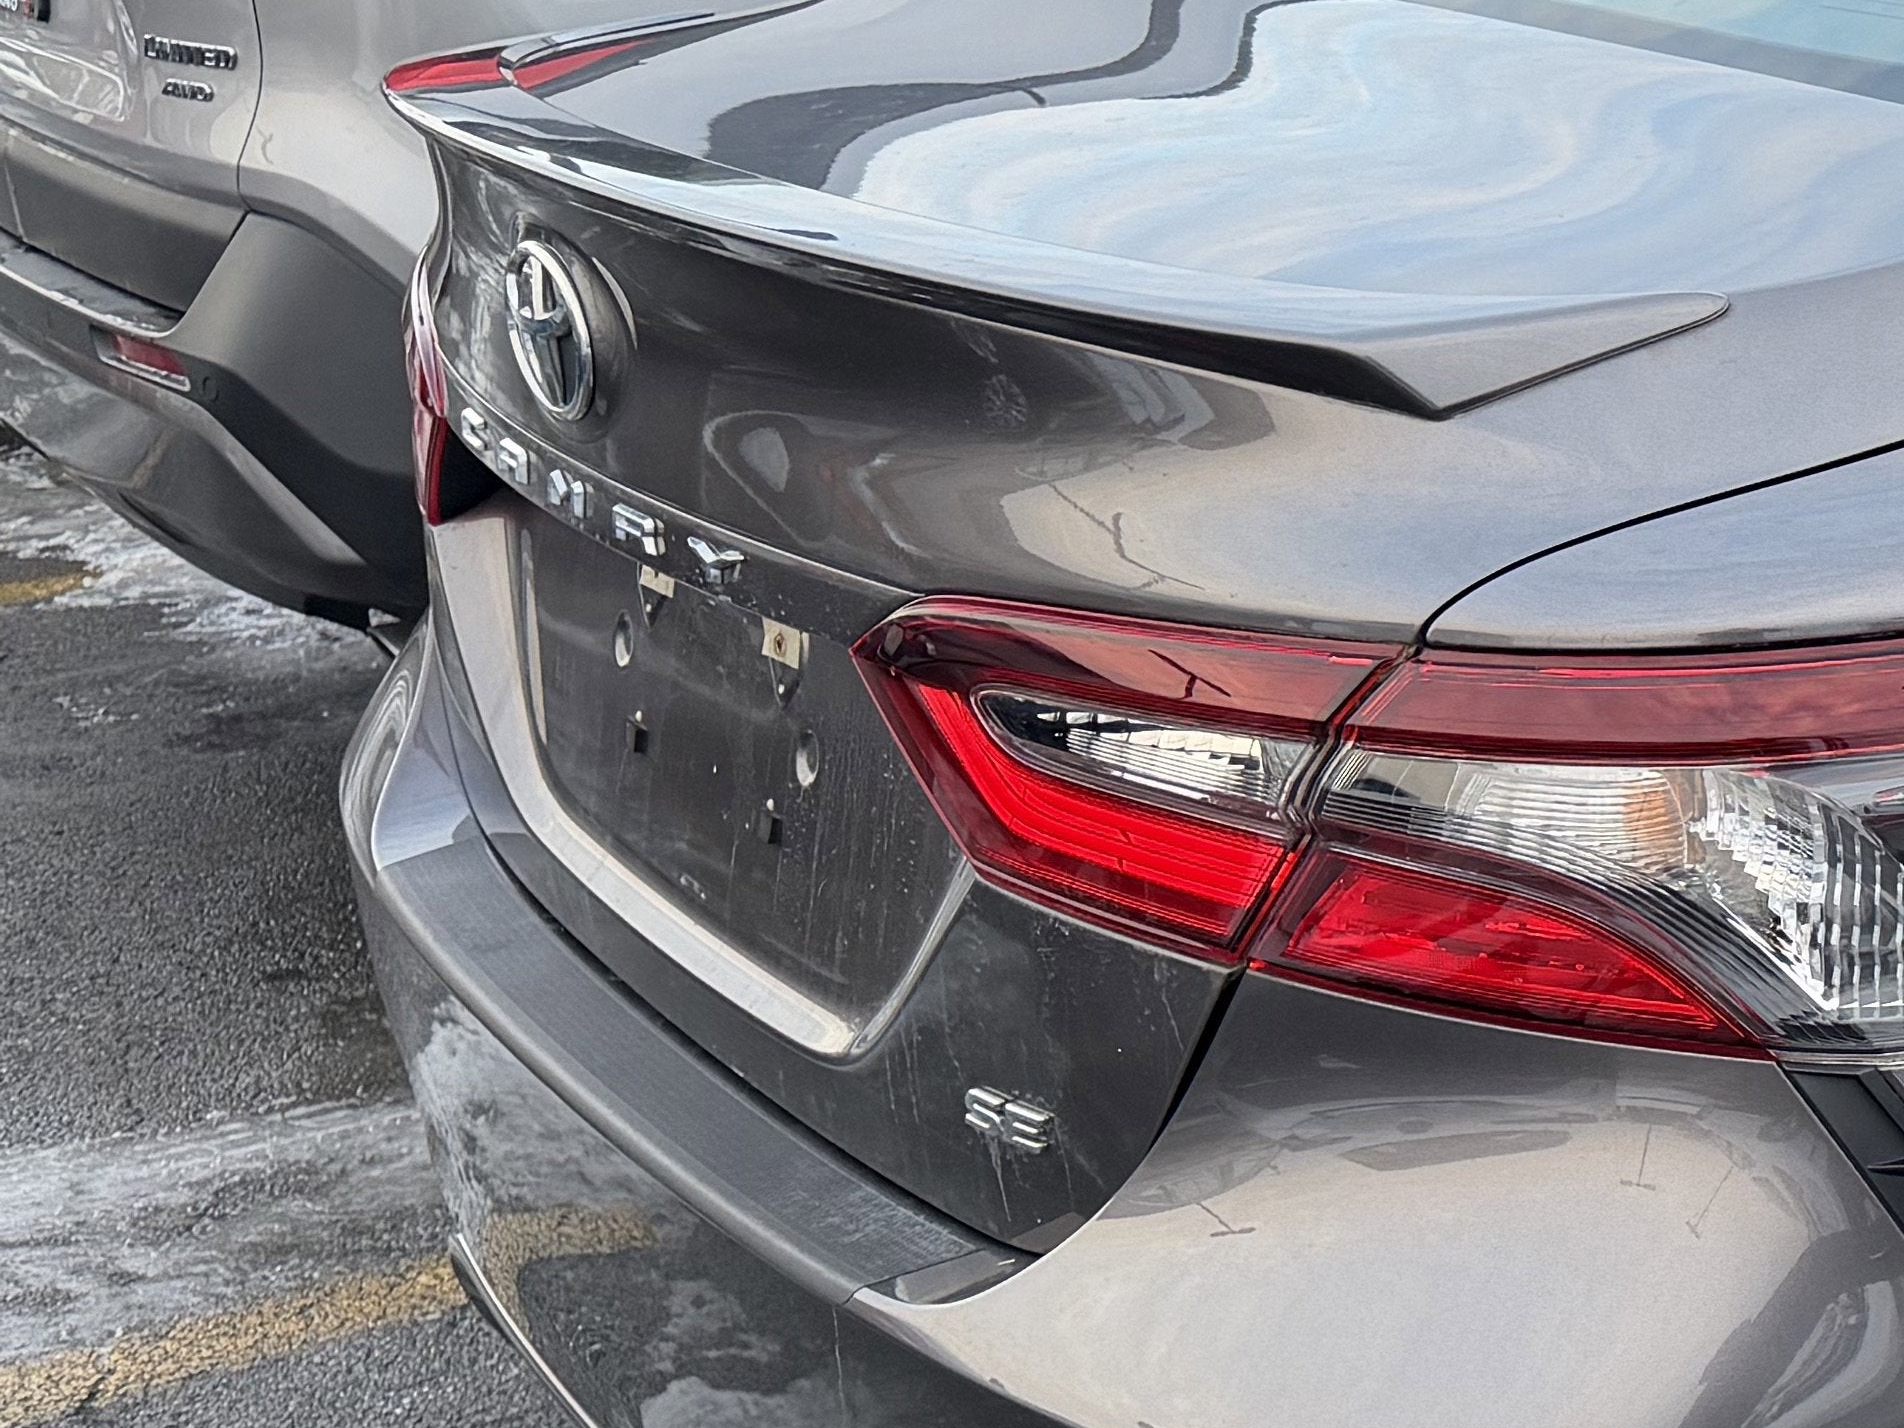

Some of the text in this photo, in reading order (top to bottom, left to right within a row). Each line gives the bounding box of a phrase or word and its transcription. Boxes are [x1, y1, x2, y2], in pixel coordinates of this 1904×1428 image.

[161, 77, 215, 102] AWD
[460, 406, 746, 585] CAMRY
[965, 1086, 1055, 1154] SE
